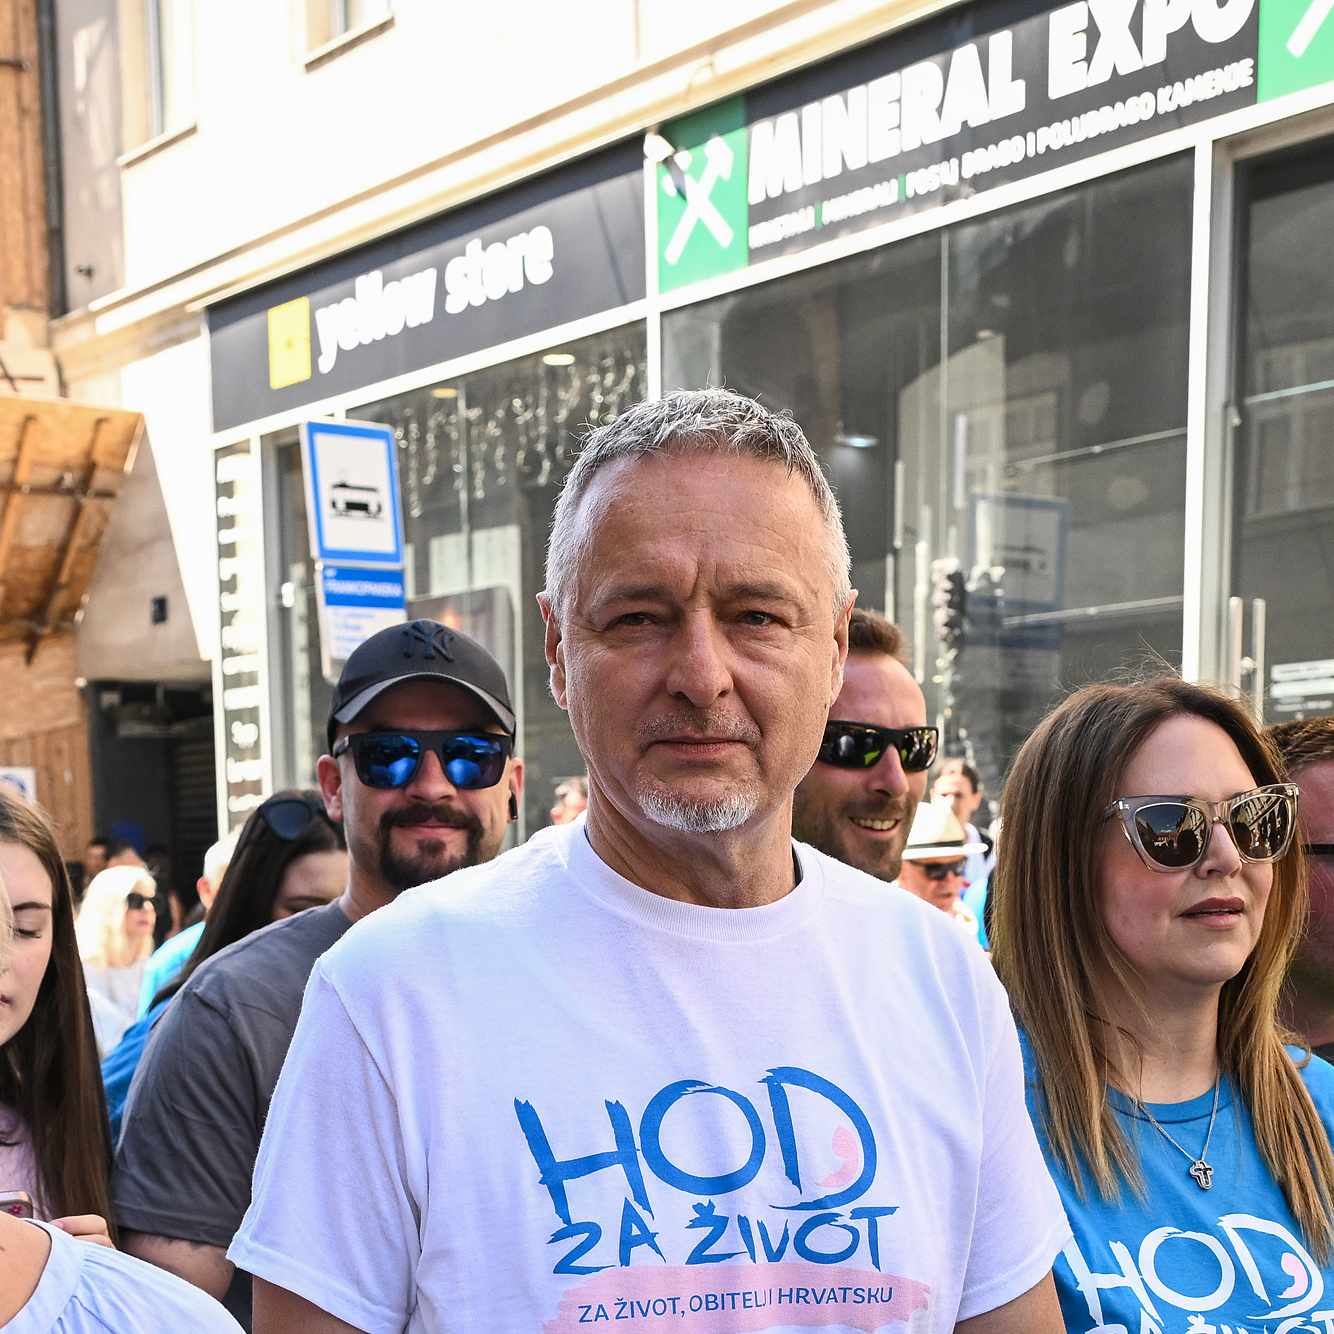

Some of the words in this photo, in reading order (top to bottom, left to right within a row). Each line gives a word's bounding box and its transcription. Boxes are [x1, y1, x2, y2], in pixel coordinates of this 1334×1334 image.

[748, 29, 1026, 206] MINERAL
[315, 270, 438, 374] yellow
[444, 225, 554, 315] store
[513, 1066, 878, 1226] HOD
[546, 1197, 667, 1276] ZA
[684, 1198, 900, 1273] ŽIVOT
[1062, 1213, 1324, 1327] HOD
[578, 1304, 610, 1324] ZA
[614, 1296, 687, 1321] ŽIVOT,
[689, 1290, 767, 1314] OBITELJ
[777, 1286, 894, 1306] HRVATSKU
